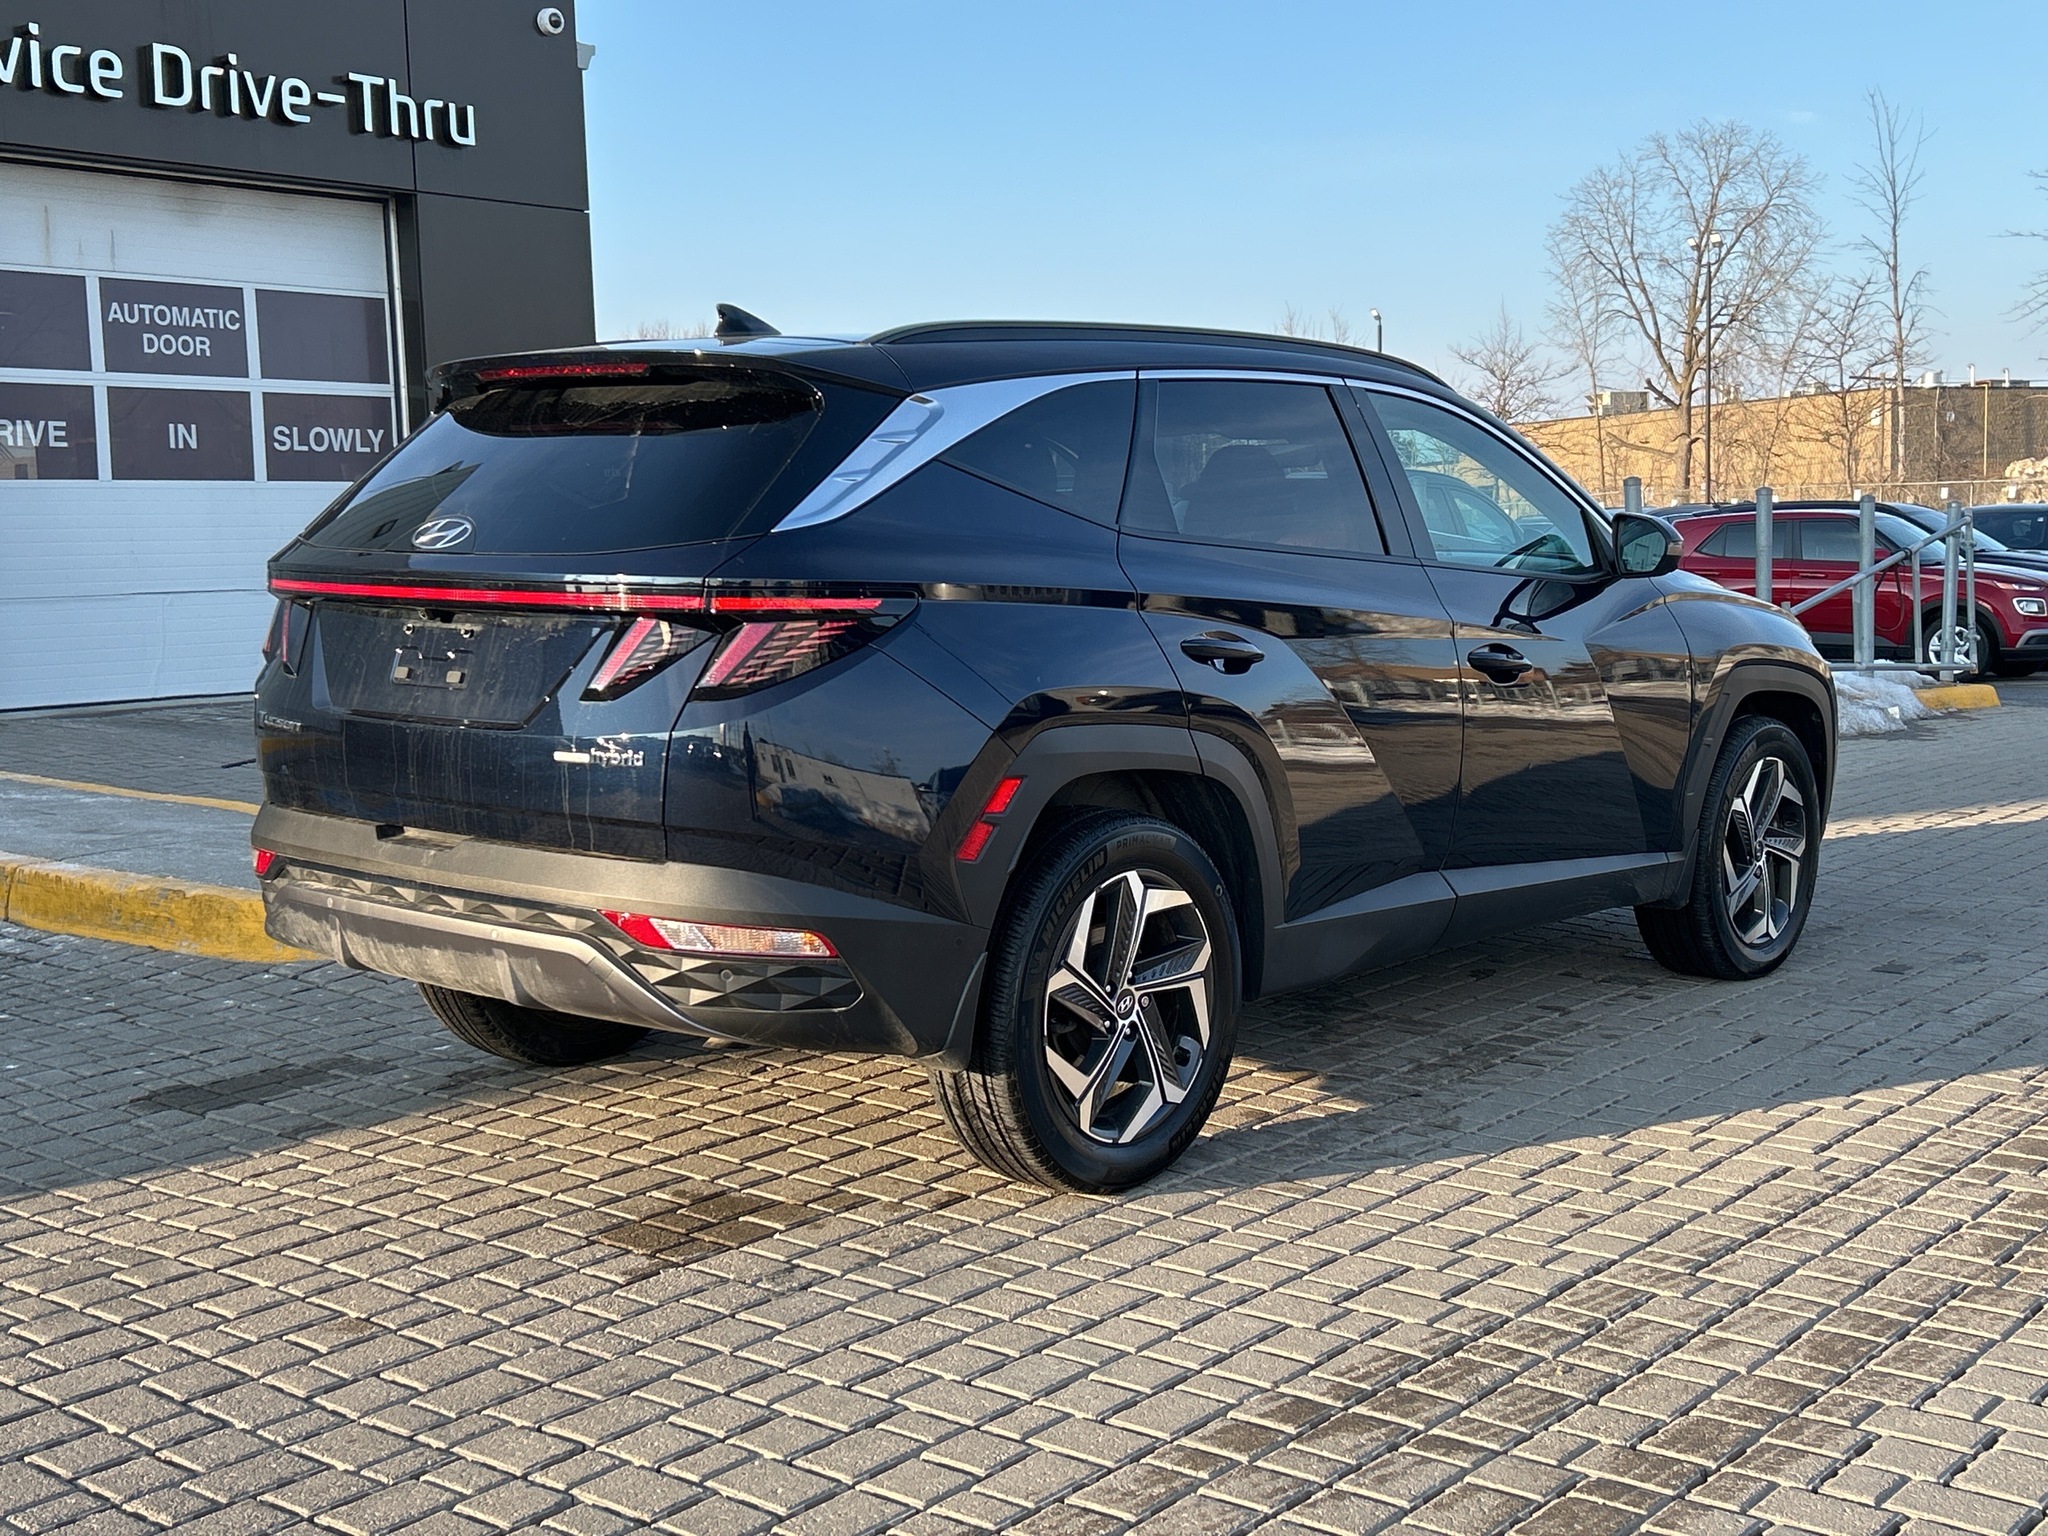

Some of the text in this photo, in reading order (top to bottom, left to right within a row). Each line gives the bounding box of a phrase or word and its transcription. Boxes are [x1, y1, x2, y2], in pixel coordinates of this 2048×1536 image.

[152, 42, 476, 146] Drive-Thru
[107, 301, 241, 331] AUTOMATIC
[142, 333, 211, 357] DOOR
[0, 418, 385, 453] RIVE IN SLOWLY
[1041, 848, 1106, 947] MICHELIN
